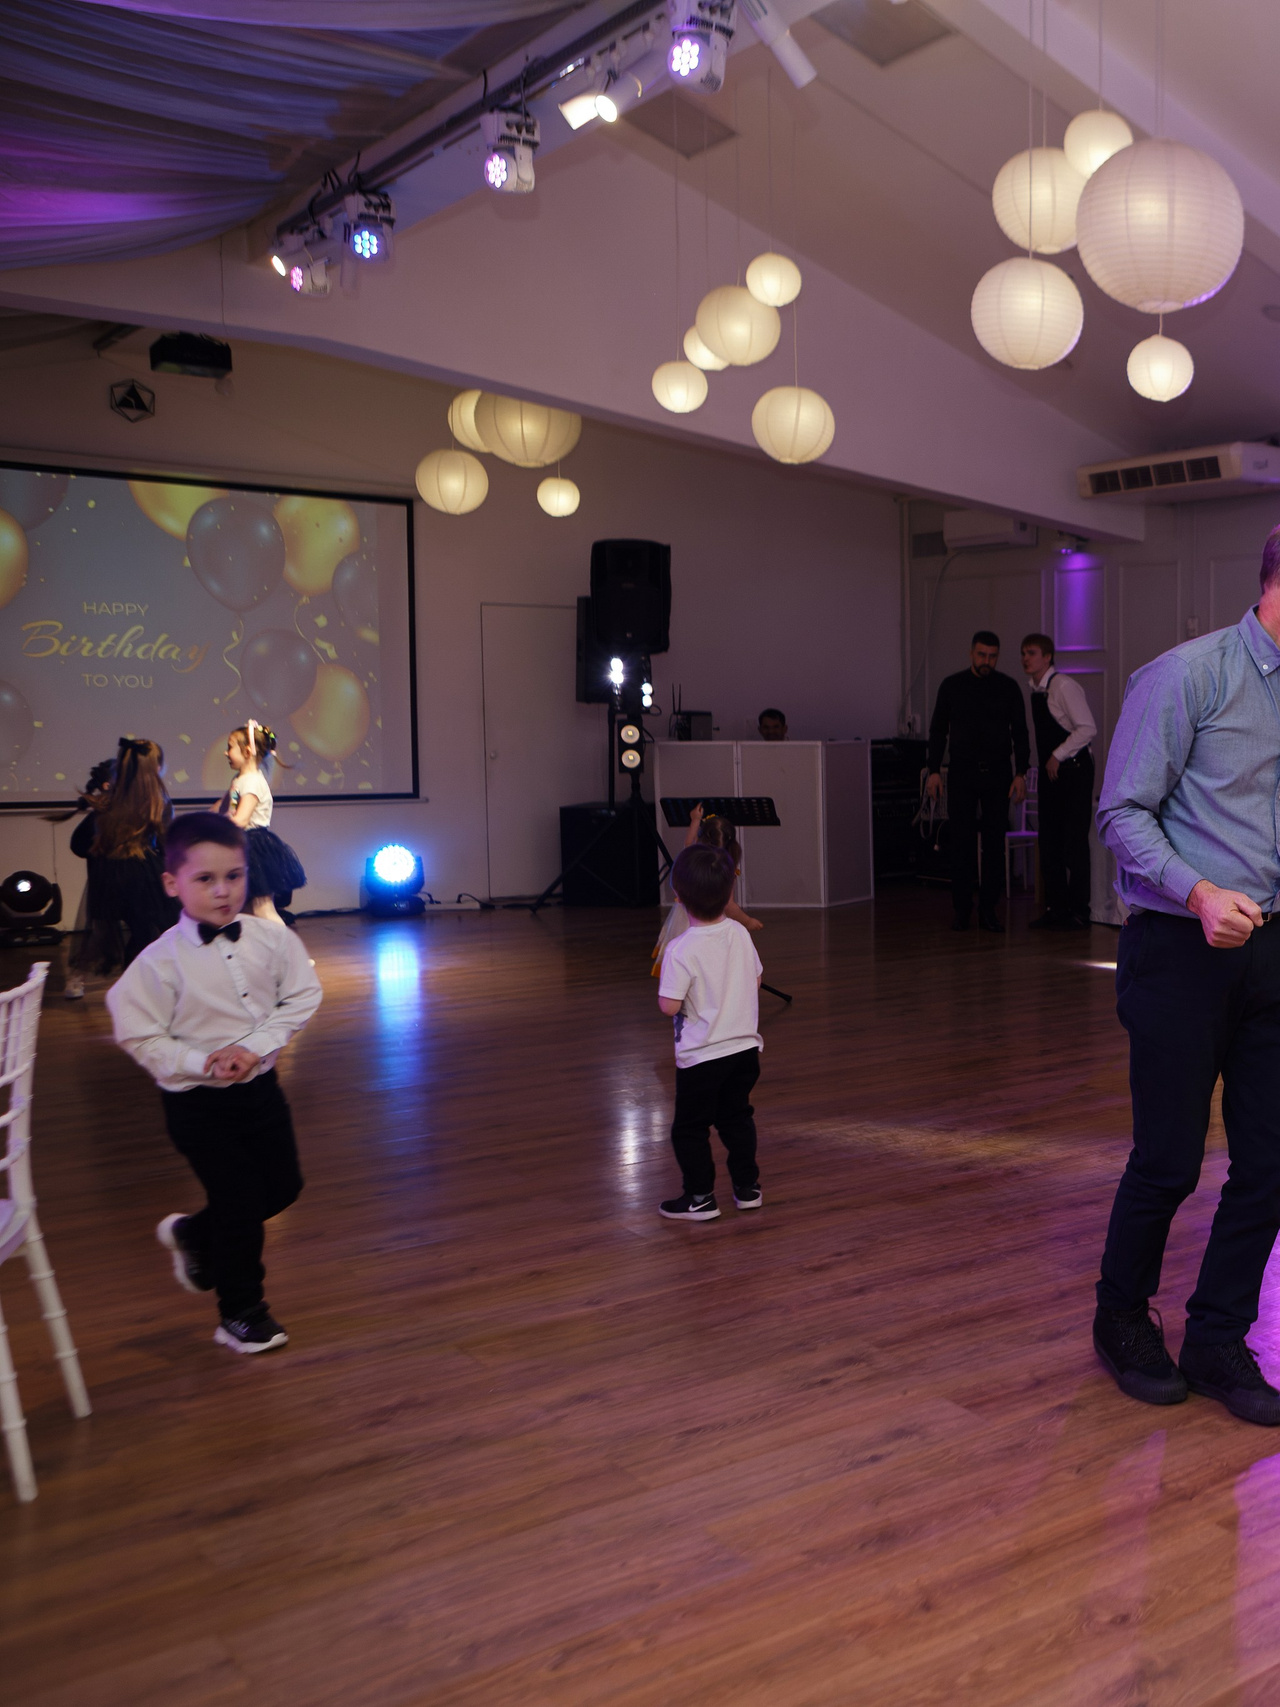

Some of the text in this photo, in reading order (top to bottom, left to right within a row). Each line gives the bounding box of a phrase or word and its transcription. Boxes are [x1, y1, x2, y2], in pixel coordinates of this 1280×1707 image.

[83, 601, 150, 617] HAPPY
[21, 619, 211, 674] Birthday
[81, 673, 154, 689] TO YOU
